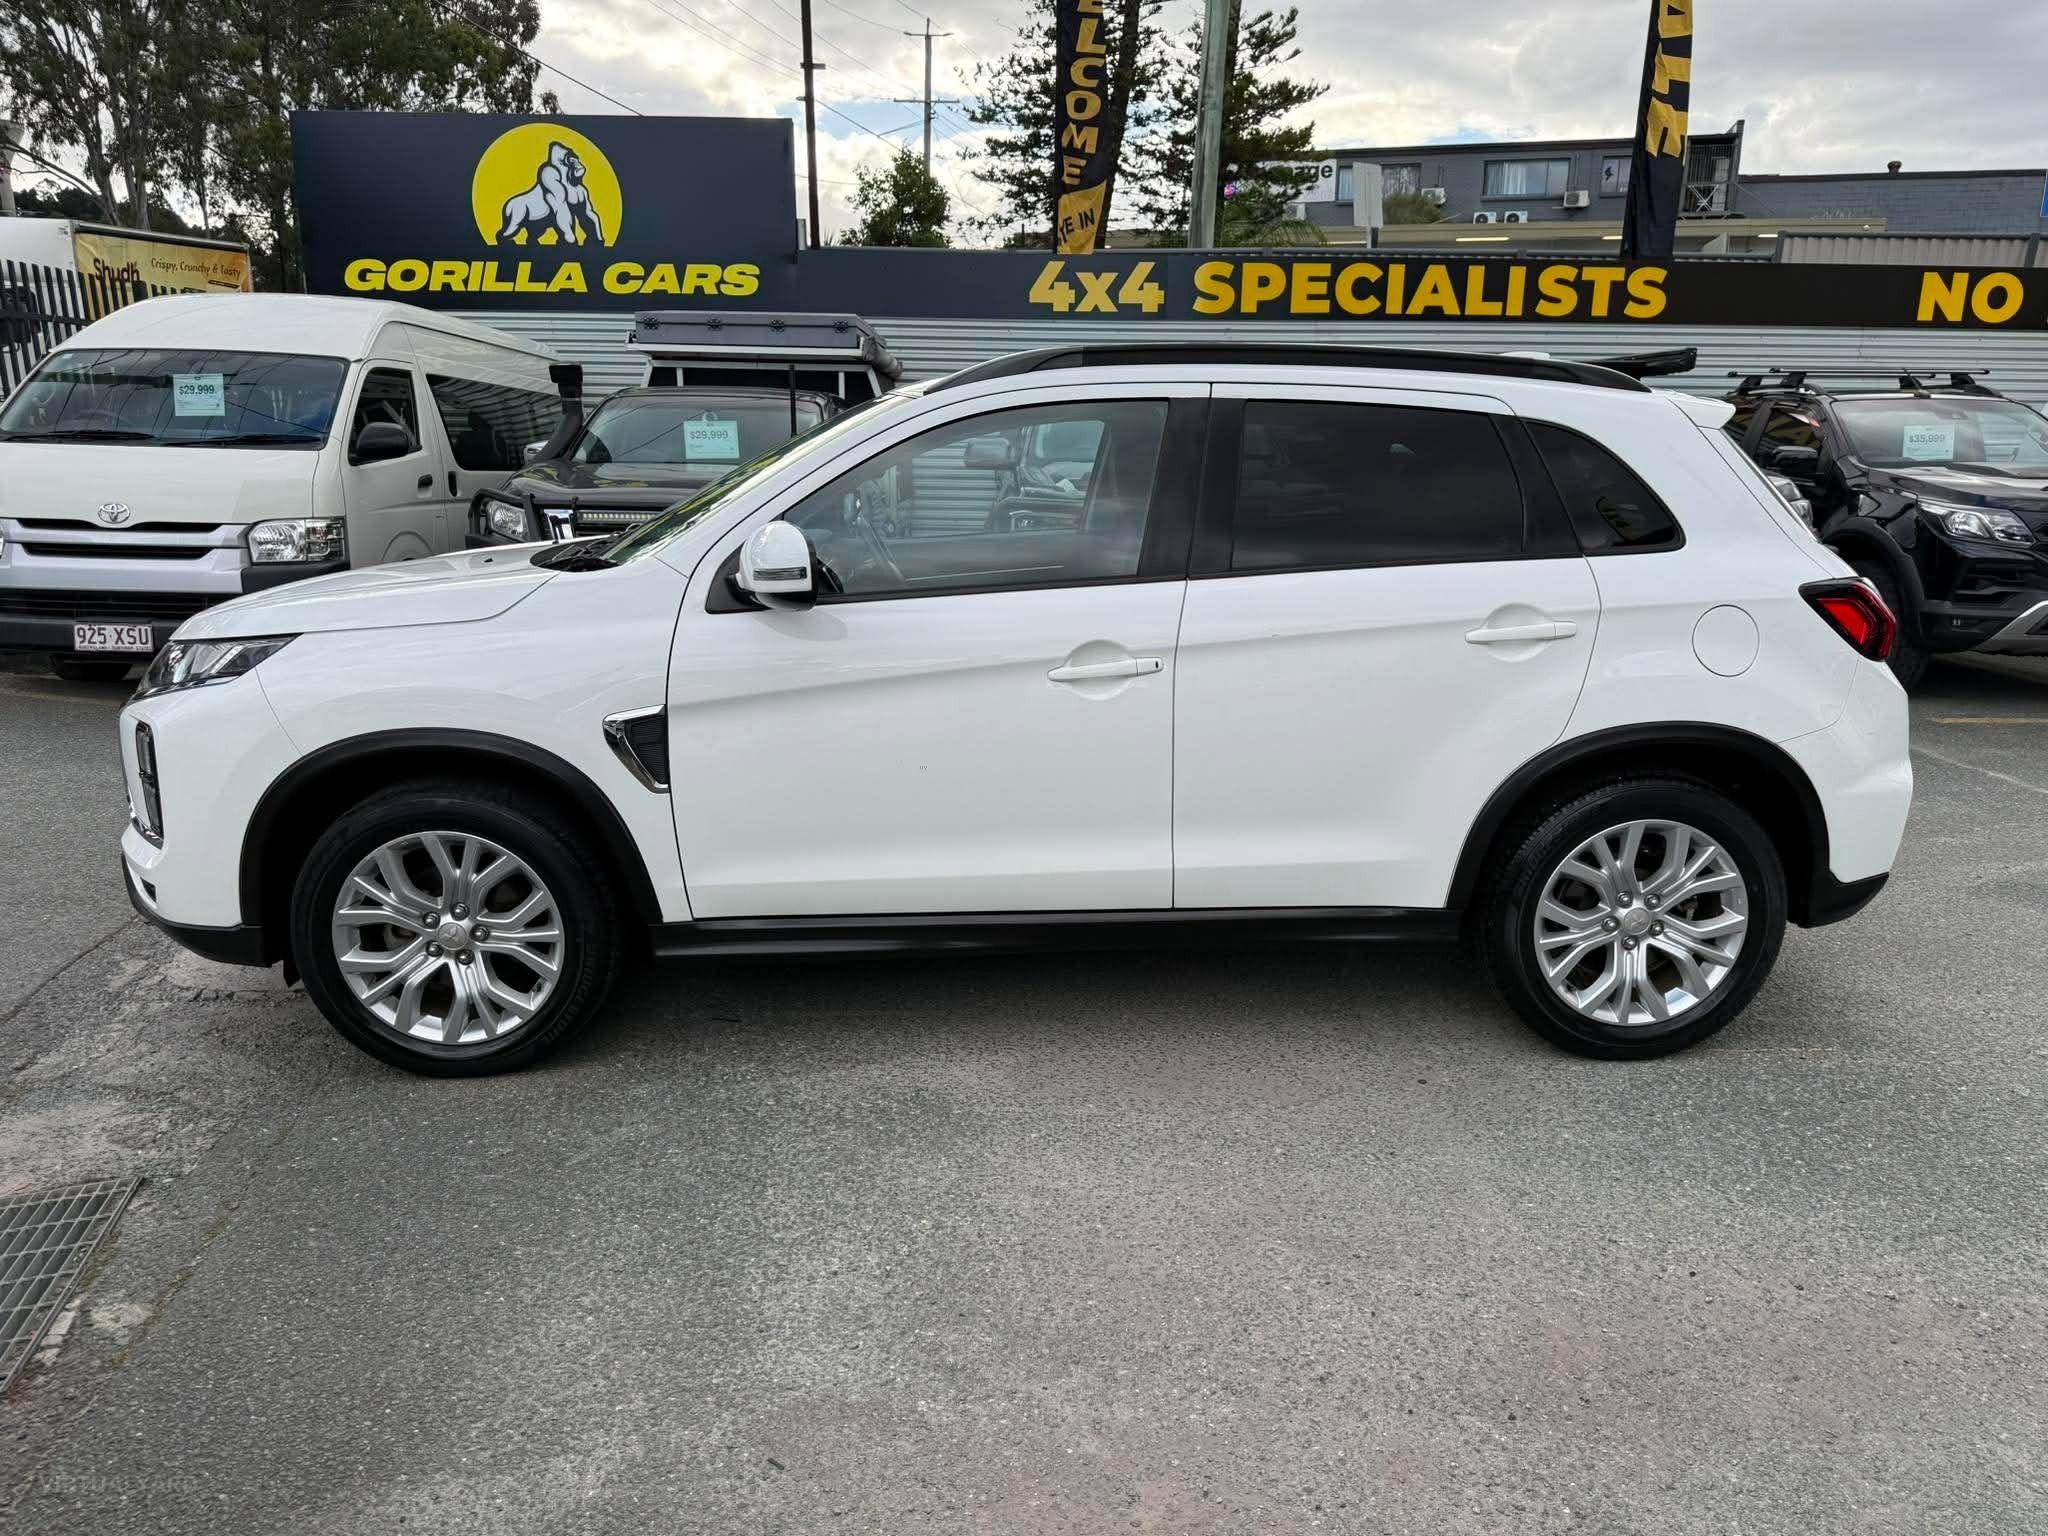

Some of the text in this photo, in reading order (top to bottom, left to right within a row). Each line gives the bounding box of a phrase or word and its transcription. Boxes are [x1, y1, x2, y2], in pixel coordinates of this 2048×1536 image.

[1078, 207, 1096, 230] IN
[151, 257, 178, 274] Crispy,
[180, 260, 211, 276] Crunchy
[344, 258, 761, 297] GORILLA CARS
[1028, 260, 1669, 320] 4x4 SPECIALISTS
[1916, 271, 2024, 324] NO
[77, 626, 150, 646] 925 XSU
